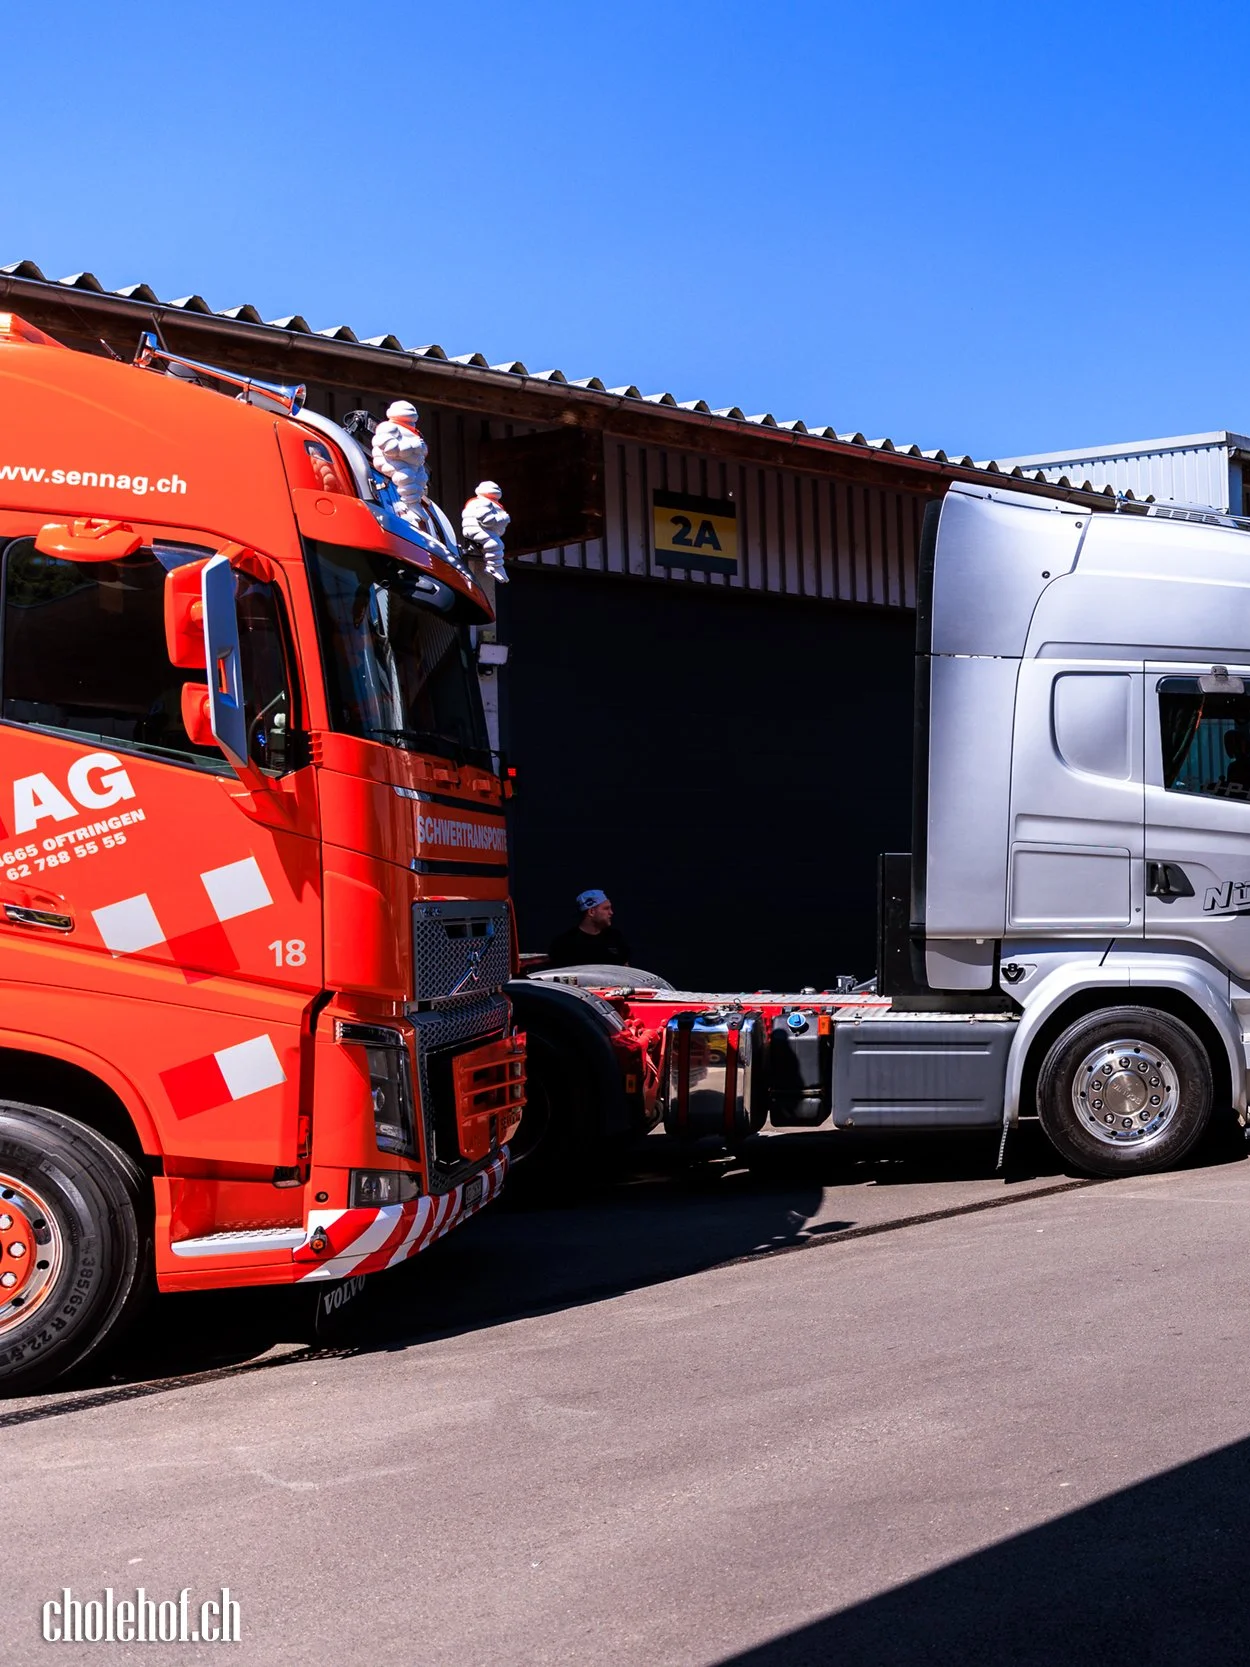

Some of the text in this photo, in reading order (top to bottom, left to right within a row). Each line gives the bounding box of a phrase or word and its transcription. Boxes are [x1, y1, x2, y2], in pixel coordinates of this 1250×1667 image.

[669, 515, 722, 551] 2A
[13, 752, 136, 835] AG
[42, 808, 146, 851] OFTRINGEN
[6, 832, 127, 881] 62 788 55 55
[268, 939, 306, 967] 18
[323, 1274, 366, 1315] VOLVO
